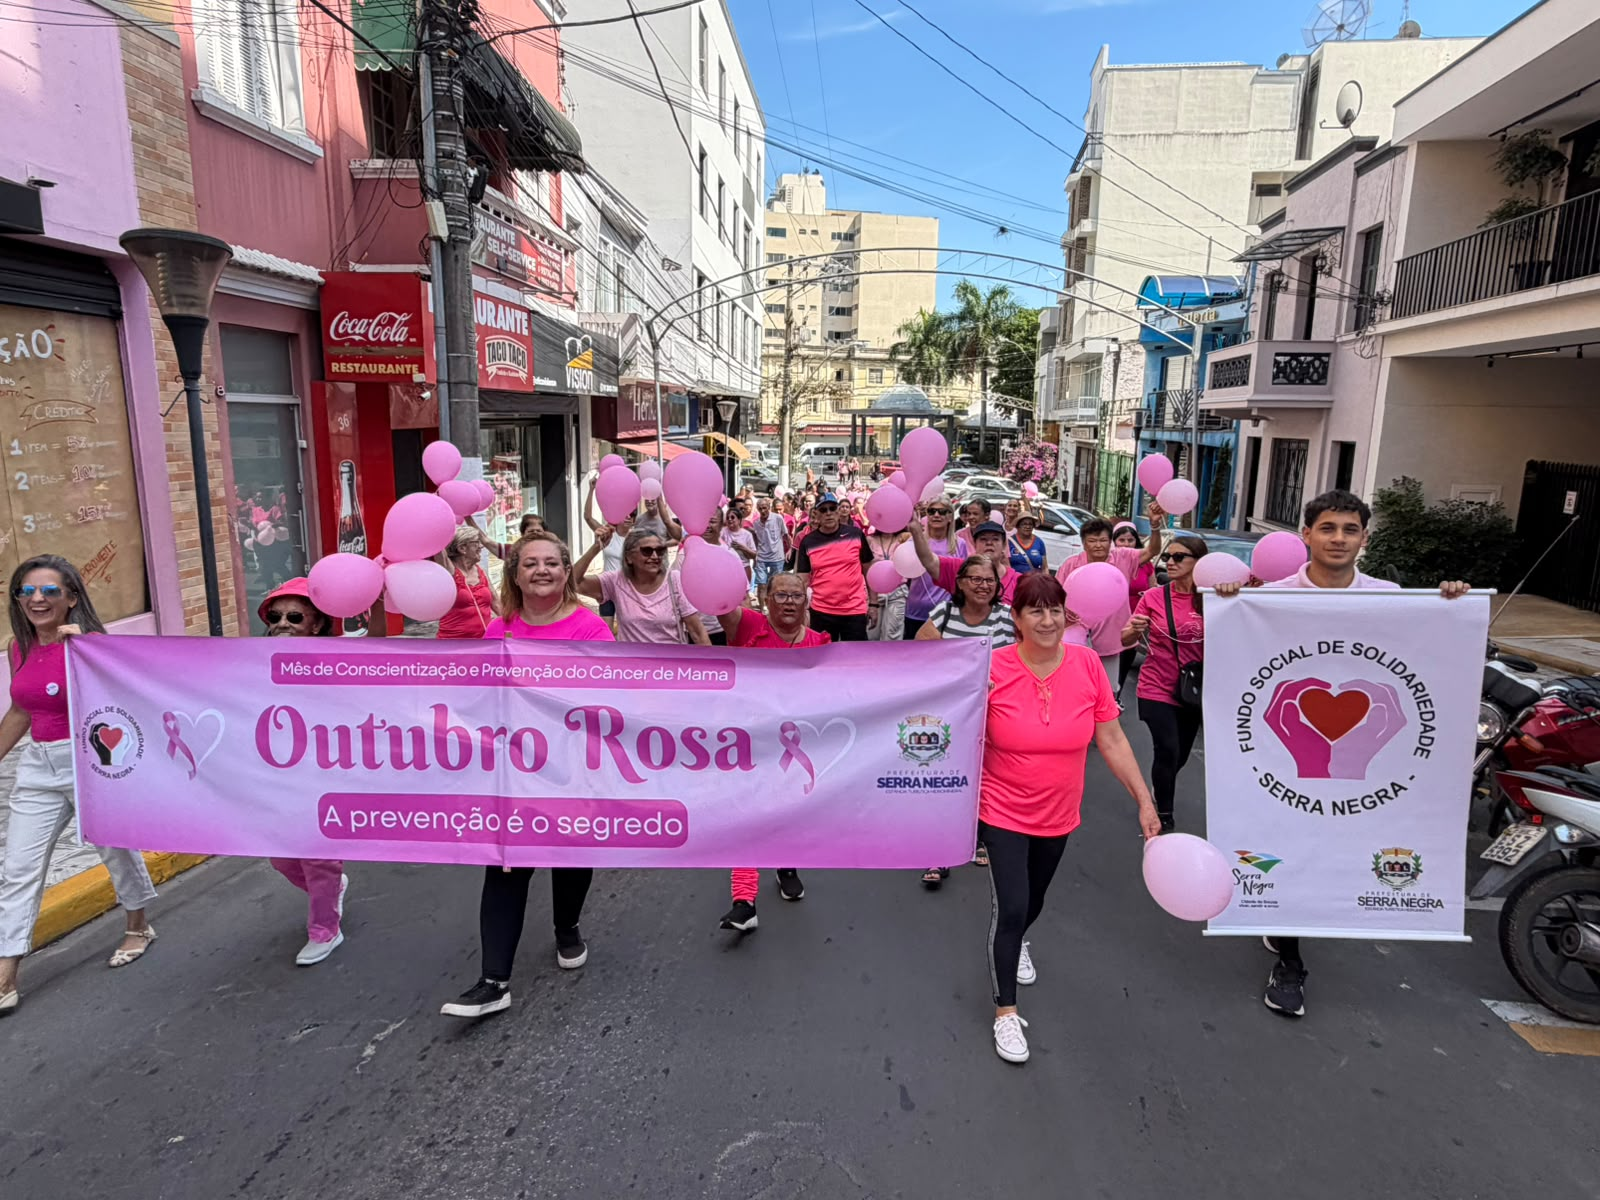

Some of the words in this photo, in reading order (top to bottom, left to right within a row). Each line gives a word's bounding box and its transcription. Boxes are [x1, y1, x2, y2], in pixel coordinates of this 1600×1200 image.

[487, 236, 537, 272] SELF-SERVICE
[330, 311, 413, 342] Coca-Cola
[487, 343, 507, 363] TACO
[508, 346, 526, 369] TACO
[331, 362, 419, 375] RESTAURANTE
[338, 414, 350, 430] 36
[10, 438, 23, 456] 1
[15, 471, 30, 490] 2
[22, 514, 36, 533] 3
[280, 661, 311, 676] Mês
[313, 661, 333, 676] de
[335, 662, 467, 681] Conscientização
[469, 664, 479, 677] e
[481, 663, 563, 681] Prevenção
[565, 664, 587, 680] do
[589, 665, 650, 681] Câncer
[652, 666, 674, 681] de
[677, 667, 729, 682] Mama
[1236, 691, 1256, 753] FUNDO
[1250, 645, 1313, 689] SOCIAL
[1317, 640, 1345, 655] DE
[1350, 642, 1436, 759] SOLIDARIEDADE
[84, 708, 104, 727] SOCIAL
[116, 707, 145, 760] SOLIDARIEDADE
[254, 703, 549, 773] Outubro
[564, 705, 757, 784] Rosa
[91, 763, 112, 779] SERRA
[112, 766, 135, 780] NEGRA
[876, 776, 922, 789] SERRA
[922, 775, 969, 789] NEGRA
[1258, 772, 1325, 816] SERRA
[1331, 778, 1408, 817] NEGRA
[323, 805, 343, 827] A
[350, 806, 501, 837] prevenção
[506, 809, 524, 834] é
[531, 815, 550, 834] o
[556, 811, 683, 841] segredo
[1231, 867, 1262, 886] Serra
[1243, 880, 1274, 896] Negra
[1357, 896, 1399, 907] SERRA
[1400, 897, 1445, 909] NEGRA
